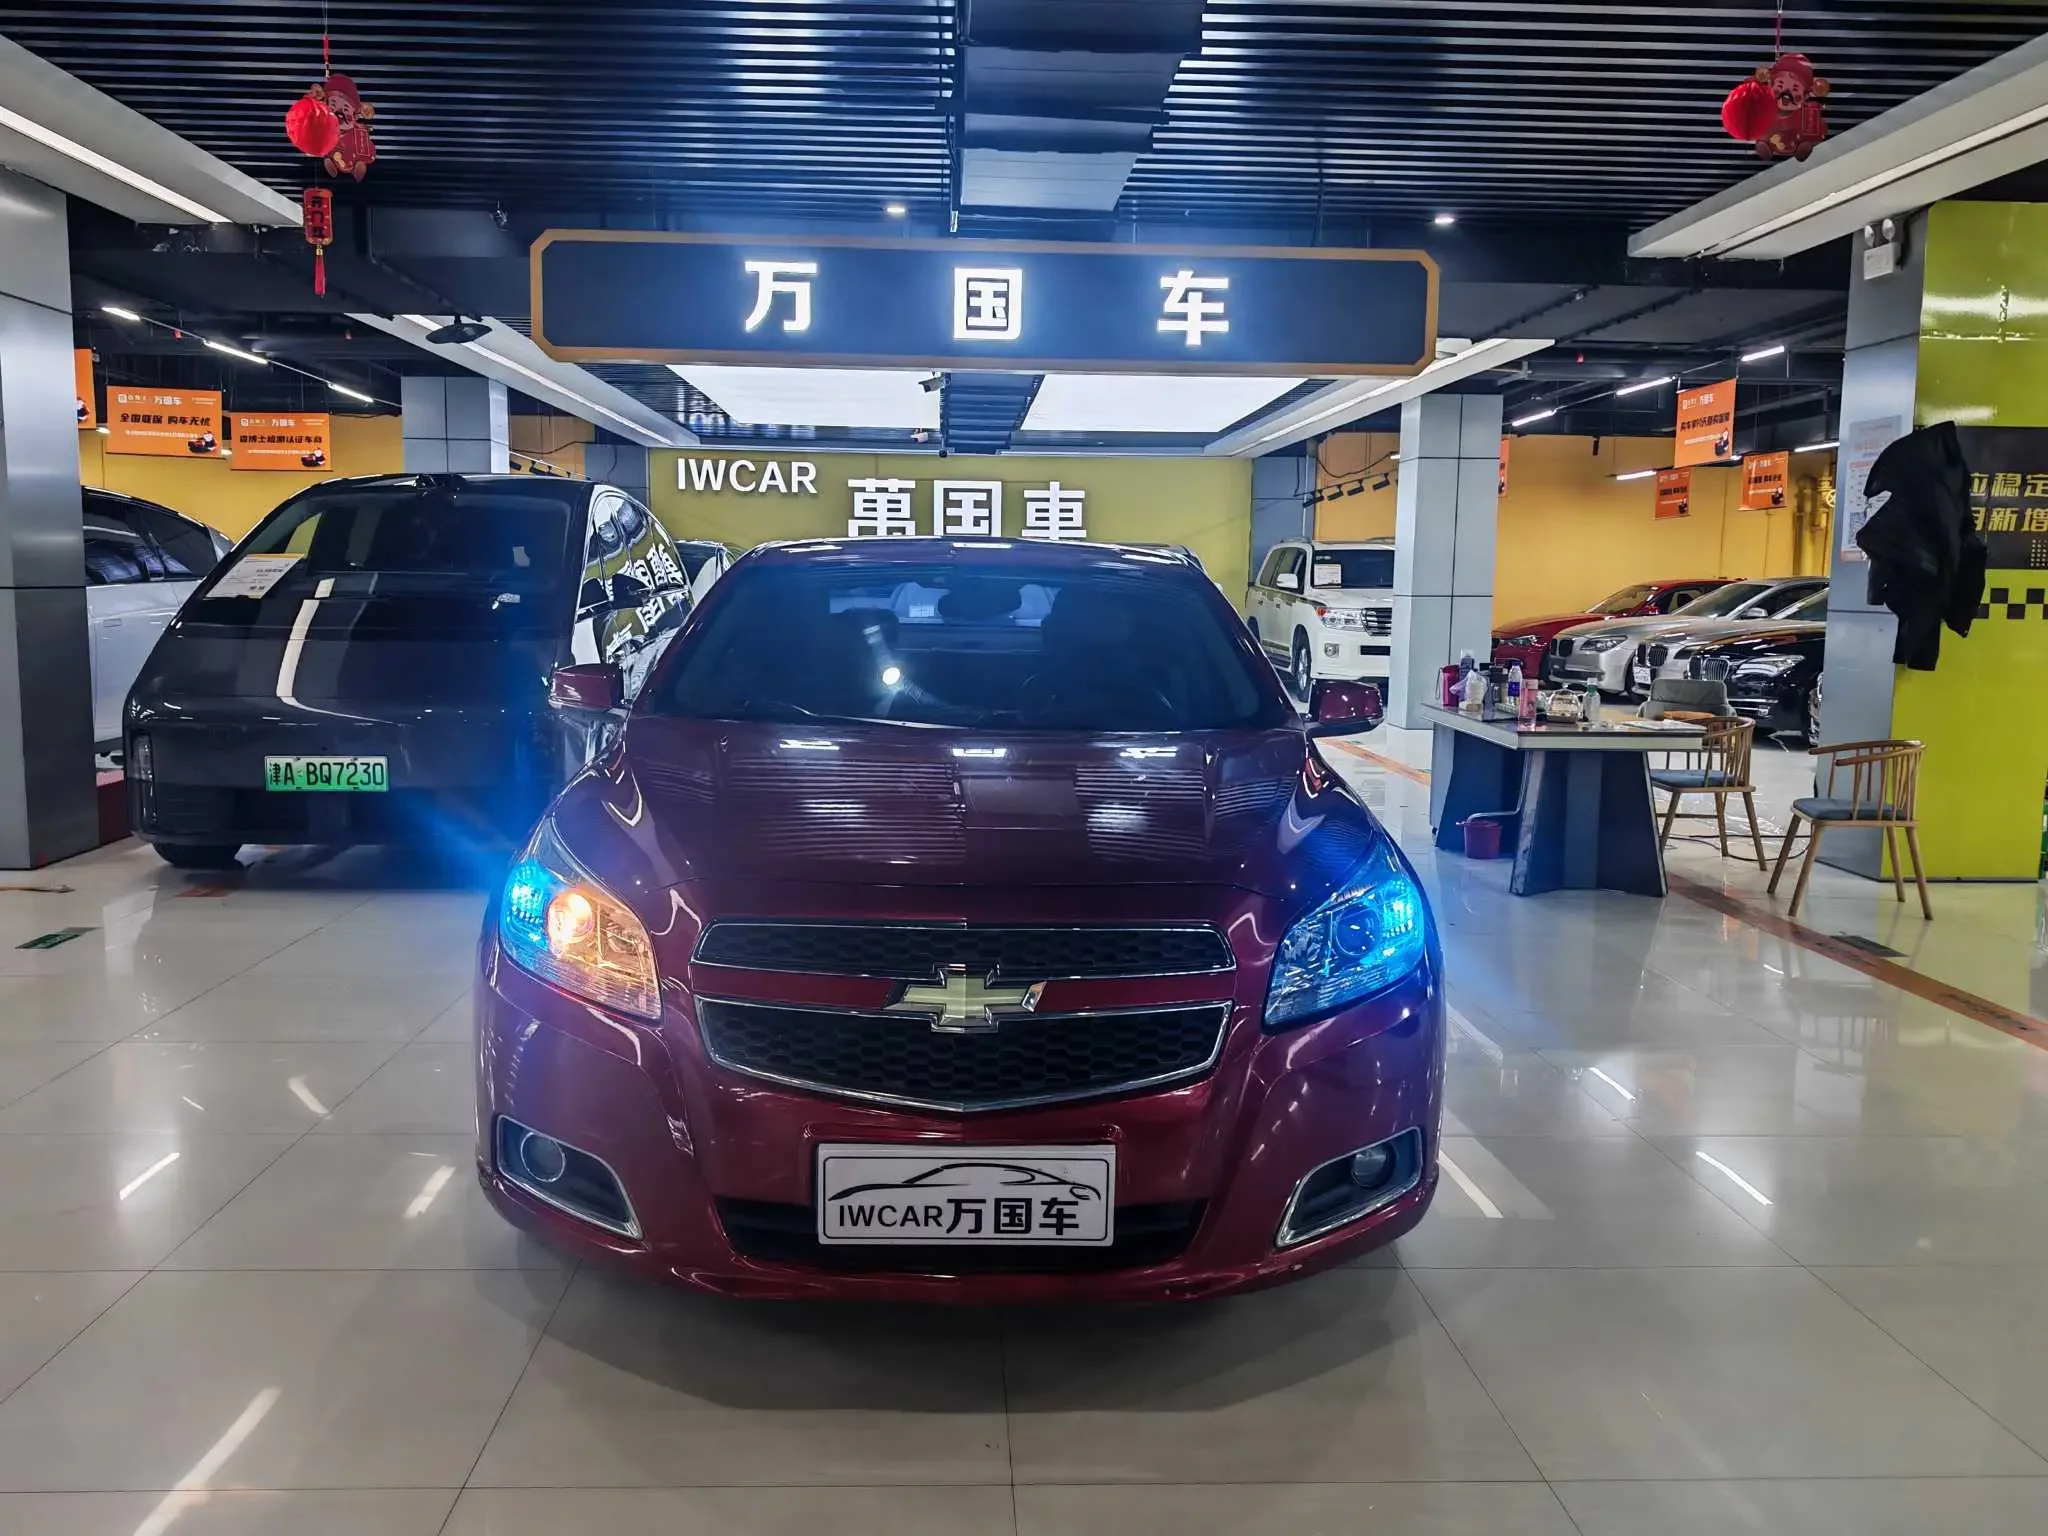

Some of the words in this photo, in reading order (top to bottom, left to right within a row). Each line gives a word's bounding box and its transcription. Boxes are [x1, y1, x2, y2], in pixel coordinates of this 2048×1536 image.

[744, 260, 1230, 346] 万国车
[677, 457, 818, 494] IWCAR
